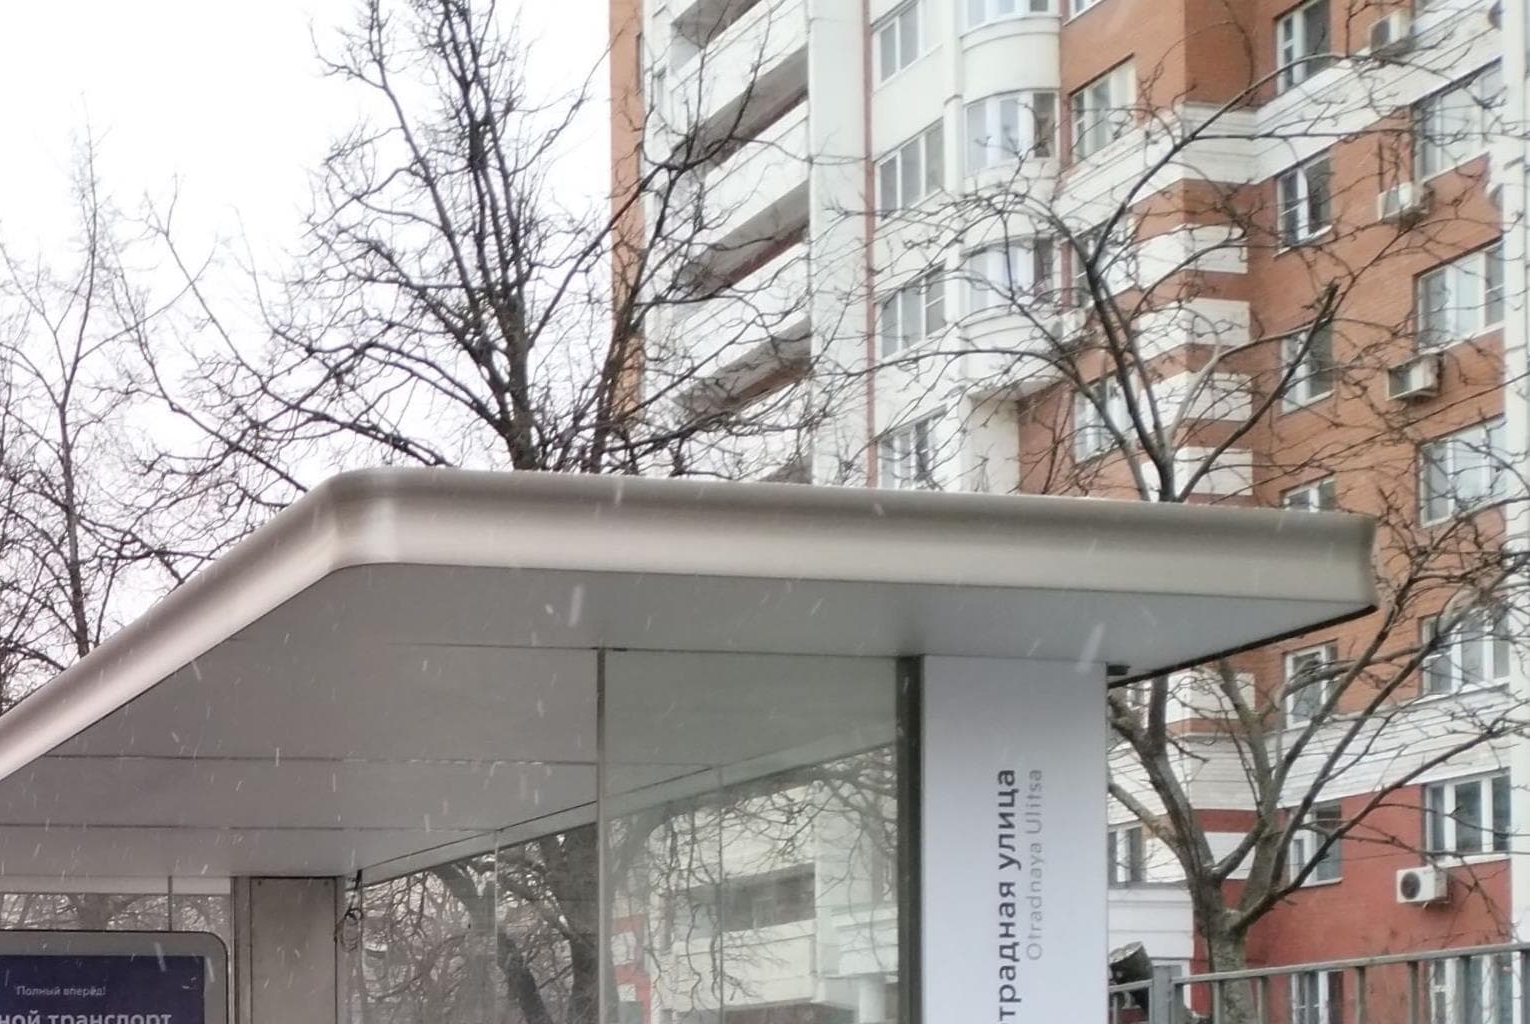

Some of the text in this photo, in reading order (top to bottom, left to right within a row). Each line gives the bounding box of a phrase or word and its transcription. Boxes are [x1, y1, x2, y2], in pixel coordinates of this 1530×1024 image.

[997, 769, 1022, 870] улица
[1024, 769, 1045, 961] Otradnaya Ulitsa
[16, 985, 61, 996] Полный
